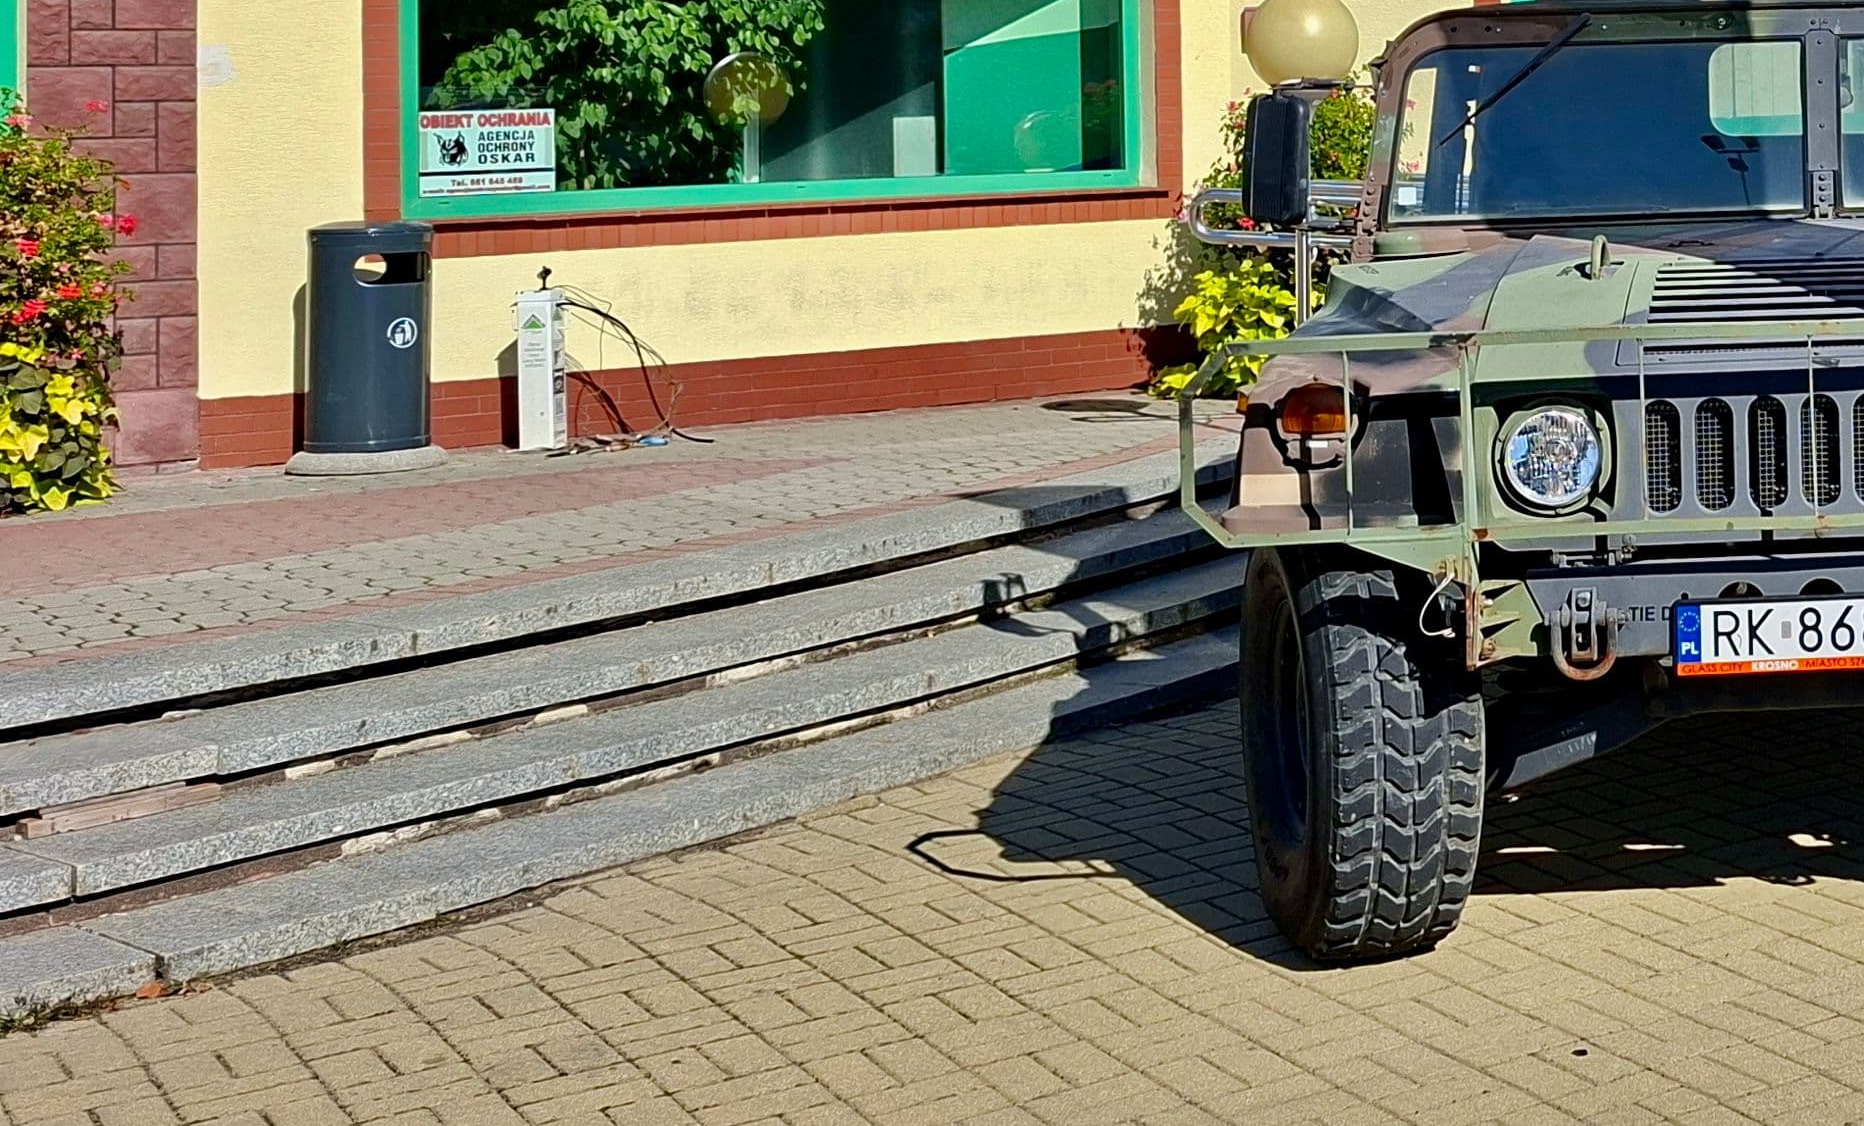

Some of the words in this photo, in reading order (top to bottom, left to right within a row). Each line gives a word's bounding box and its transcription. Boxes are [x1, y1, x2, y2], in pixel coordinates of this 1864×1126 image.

[420, 114, 474, 129] OBIEKT
[477, 112, 551, 126] OCHRANIA
[478, 130, 535, 142] AGENCJA
[478, 141, 535, 153] OCHRONY
[478, 152, 536, 165] OSKAR
[1713, 608, 1775, 657] RK
[1681, 641, 1699, 655] PL
[1682, 663, 1719, 674] GLASS
[1721, 662, 1744, 672] CITY
[1751, 659, 1799, 671] KROSNO
[1805, 657, 1848, 668] MIASTO
